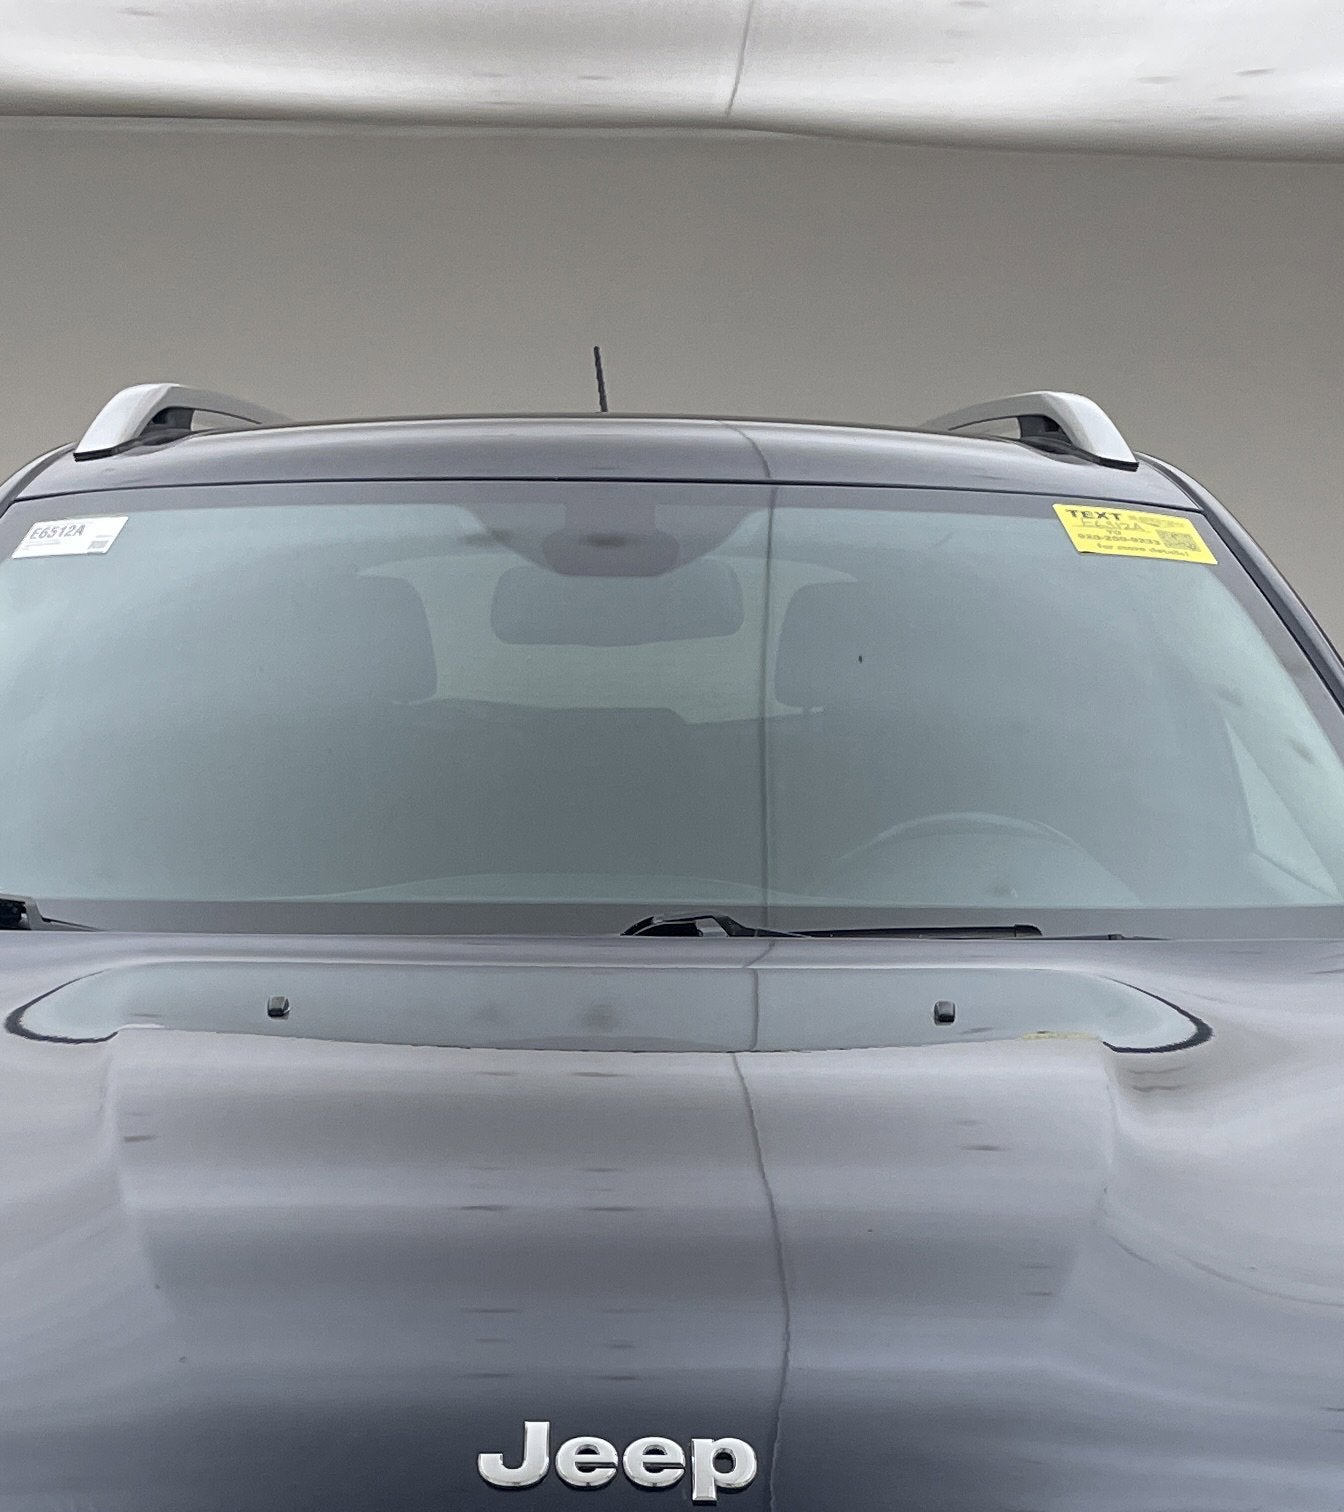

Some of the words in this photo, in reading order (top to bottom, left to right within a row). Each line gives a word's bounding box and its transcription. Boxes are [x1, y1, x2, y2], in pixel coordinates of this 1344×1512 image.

[1066, 509, 1122, 521] TEXT
[30, 524, 86, 540] E6512A
[478, 1421, 757, 1504] Jeep
